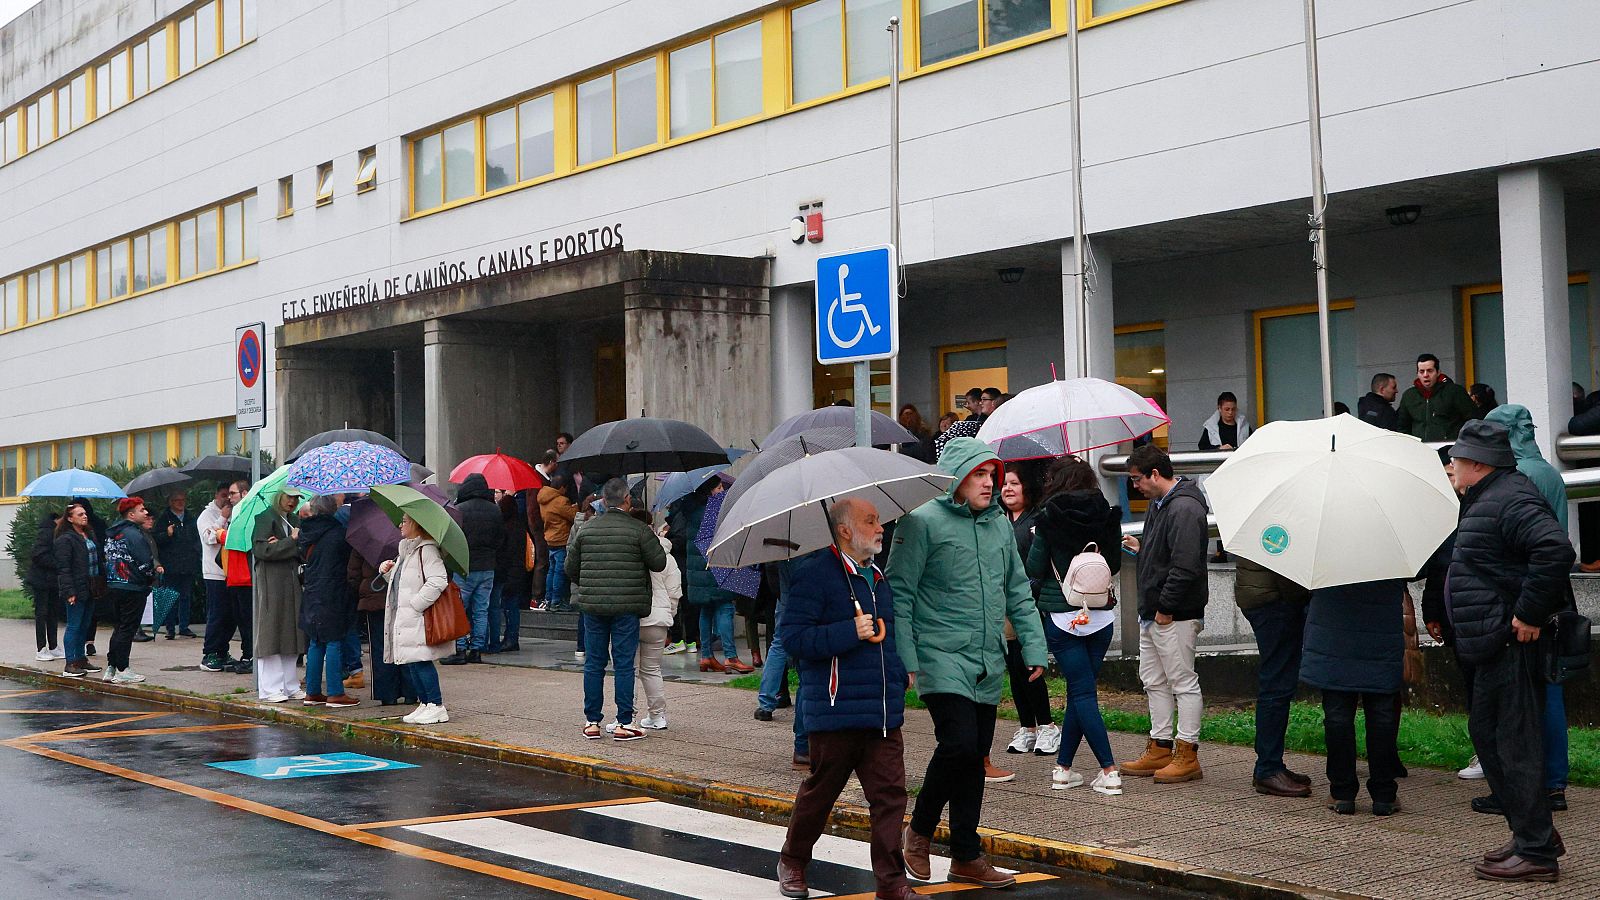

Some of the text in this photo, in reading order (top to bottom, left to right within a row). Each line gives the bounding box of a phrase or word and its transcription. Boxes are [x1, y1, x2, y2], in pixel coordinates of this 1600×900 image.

[282, 299, 310, 320] E.T.S.
[313, 278, 380, 315] ENXEÑERÍA
[384, 277, 401, 298] DE
[477, 245, 534, 278] CANAIS
[540, 240, 549, 265] E
[553, 223, 624, 261] PORTOS
